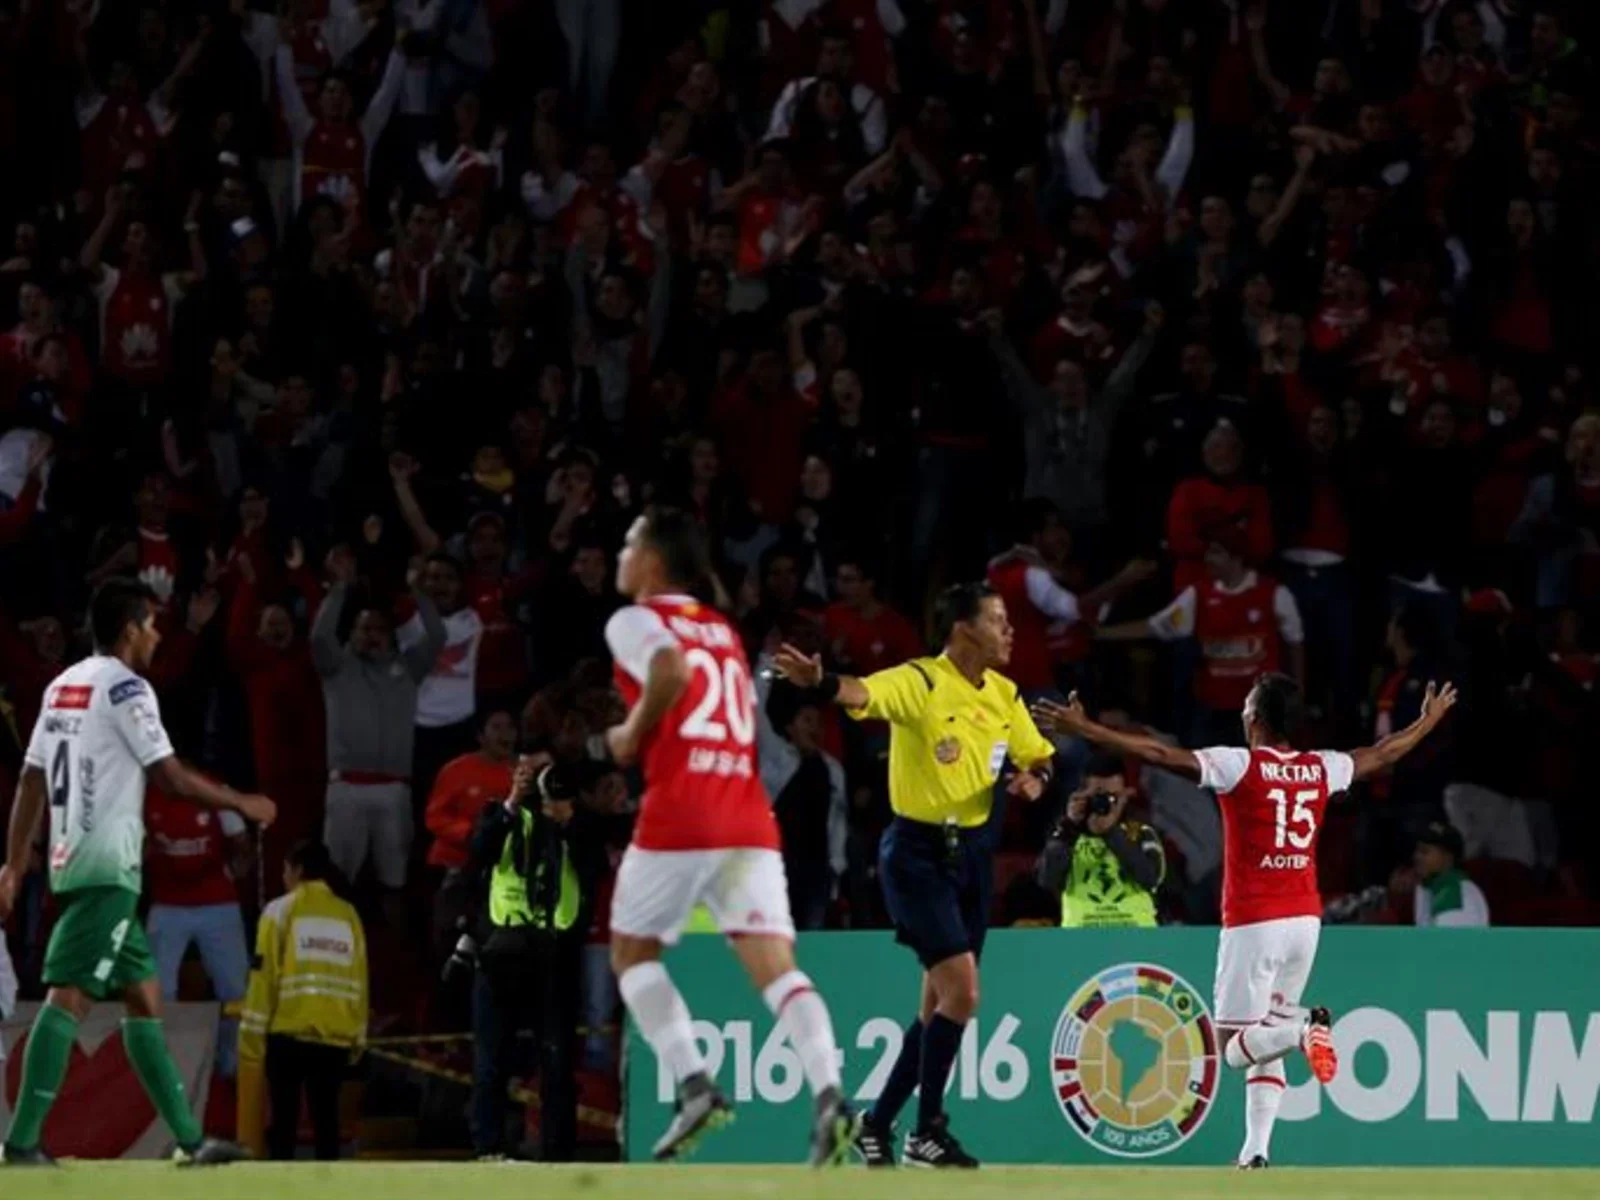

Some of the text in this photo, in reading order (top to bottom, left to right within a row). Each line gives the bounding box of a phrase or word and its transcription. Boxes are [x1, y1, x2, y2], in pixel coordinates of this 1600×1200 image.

[678, 648, 758, 745] 20
[51, 739, 70, 835] 4
[1259, 761, 1322, 783] NECTAR
[1266, 787, 1319, 849] 15
[853, 1013, 1030, 1102] 216
